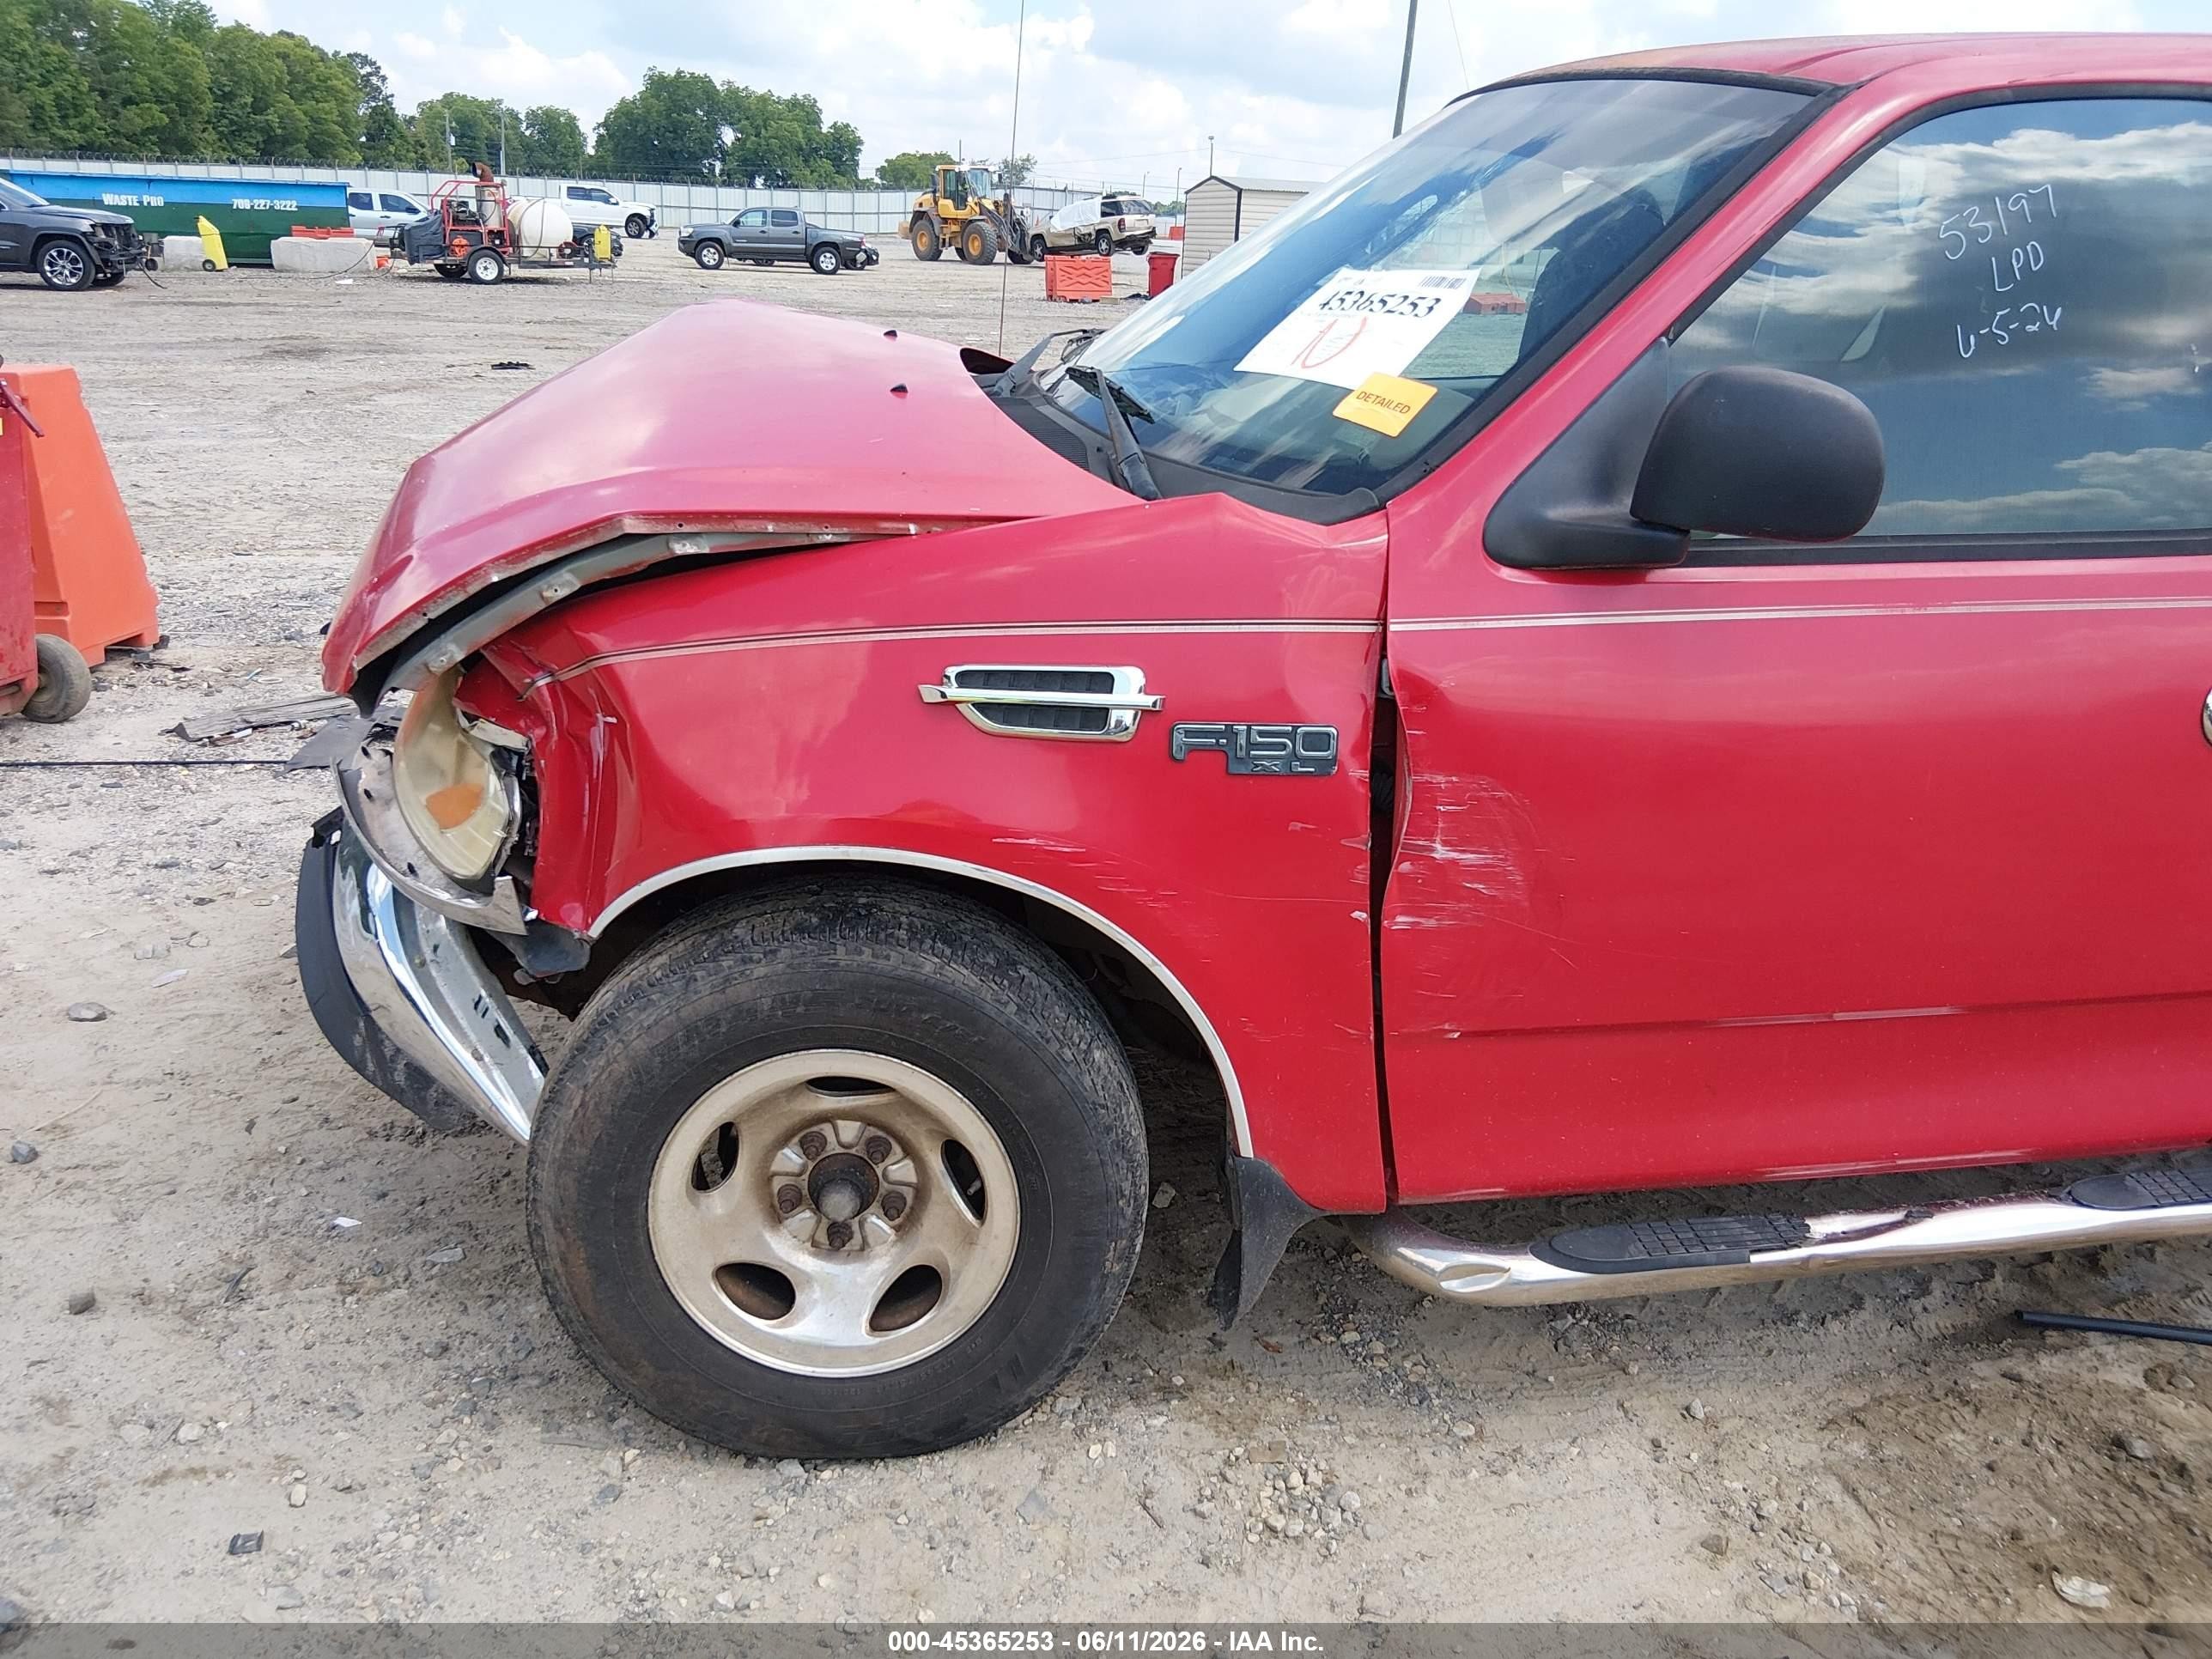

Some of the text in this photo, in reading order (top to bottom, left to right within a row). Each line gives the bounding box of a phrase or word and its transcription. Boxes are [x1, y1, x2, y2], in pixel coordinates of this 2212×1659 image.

[101, 193, 164, 207] WASTE PRO
[1937, 184, 2057, 260] 53197
[1991, 240, 2045, 292] LPD
[1319, 289, 1442, 319] 45365253
[1355, 390, 1412, 416] DETAILED
[1172, 724, 1338, 760] F-150
[1252, 760, 1316, 772] XL
